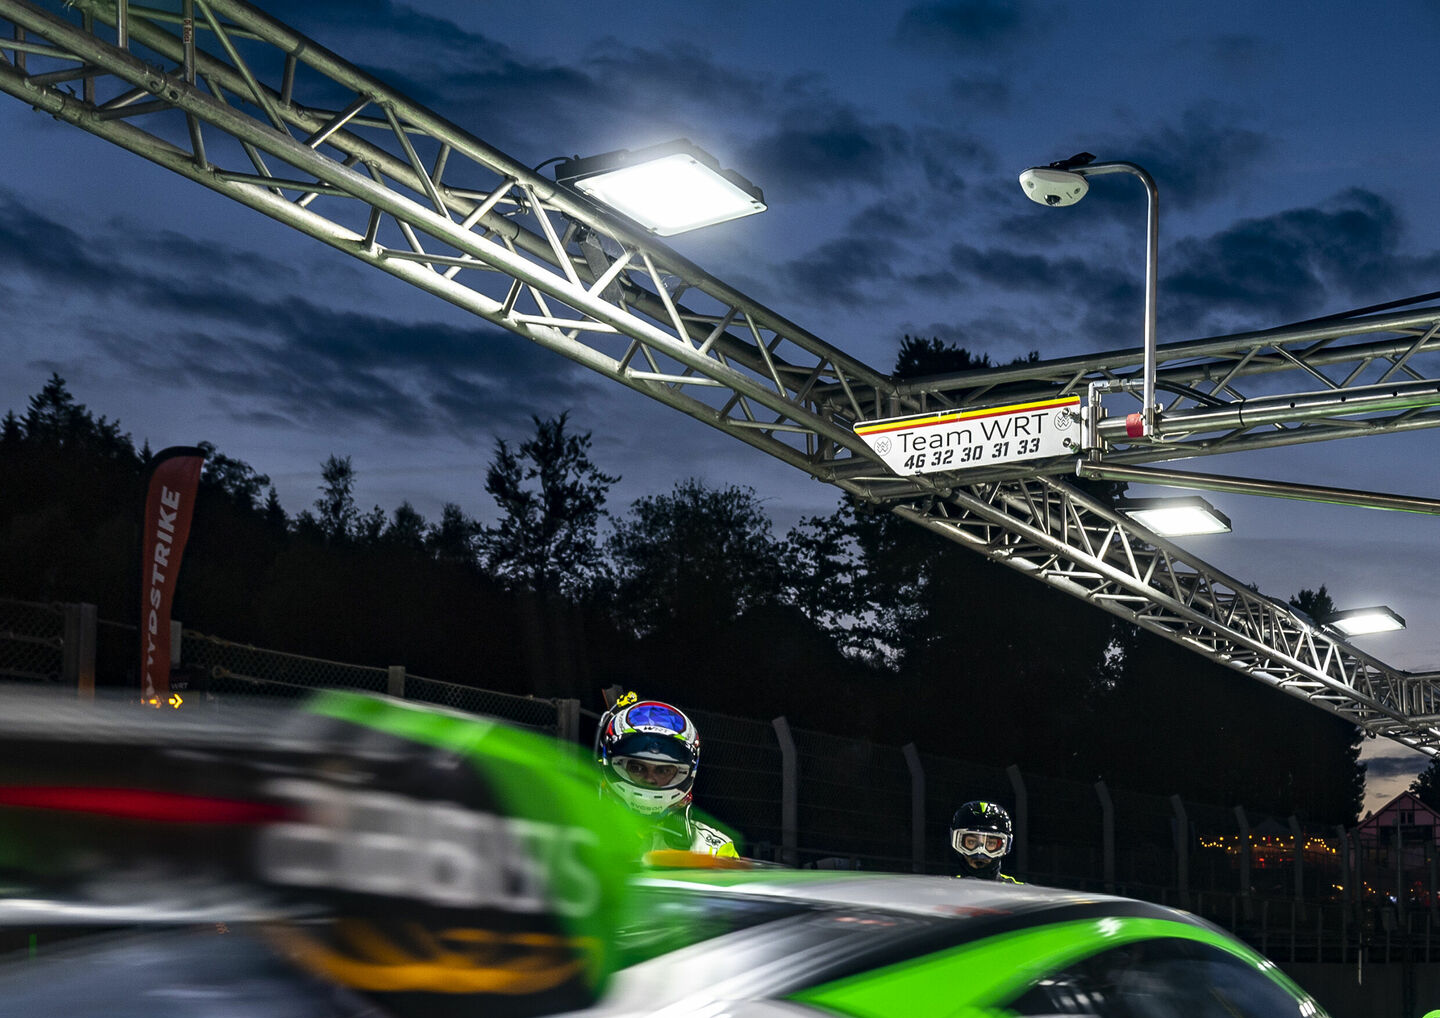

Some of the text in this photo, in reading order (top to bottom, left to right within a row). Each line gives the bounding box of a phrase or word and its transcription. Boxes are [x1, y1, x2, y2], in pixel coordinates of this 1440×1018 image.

[897, 412, 1049, 453] Team WRT
[904, 437, 1040, 470] 46 32 30 31 33
